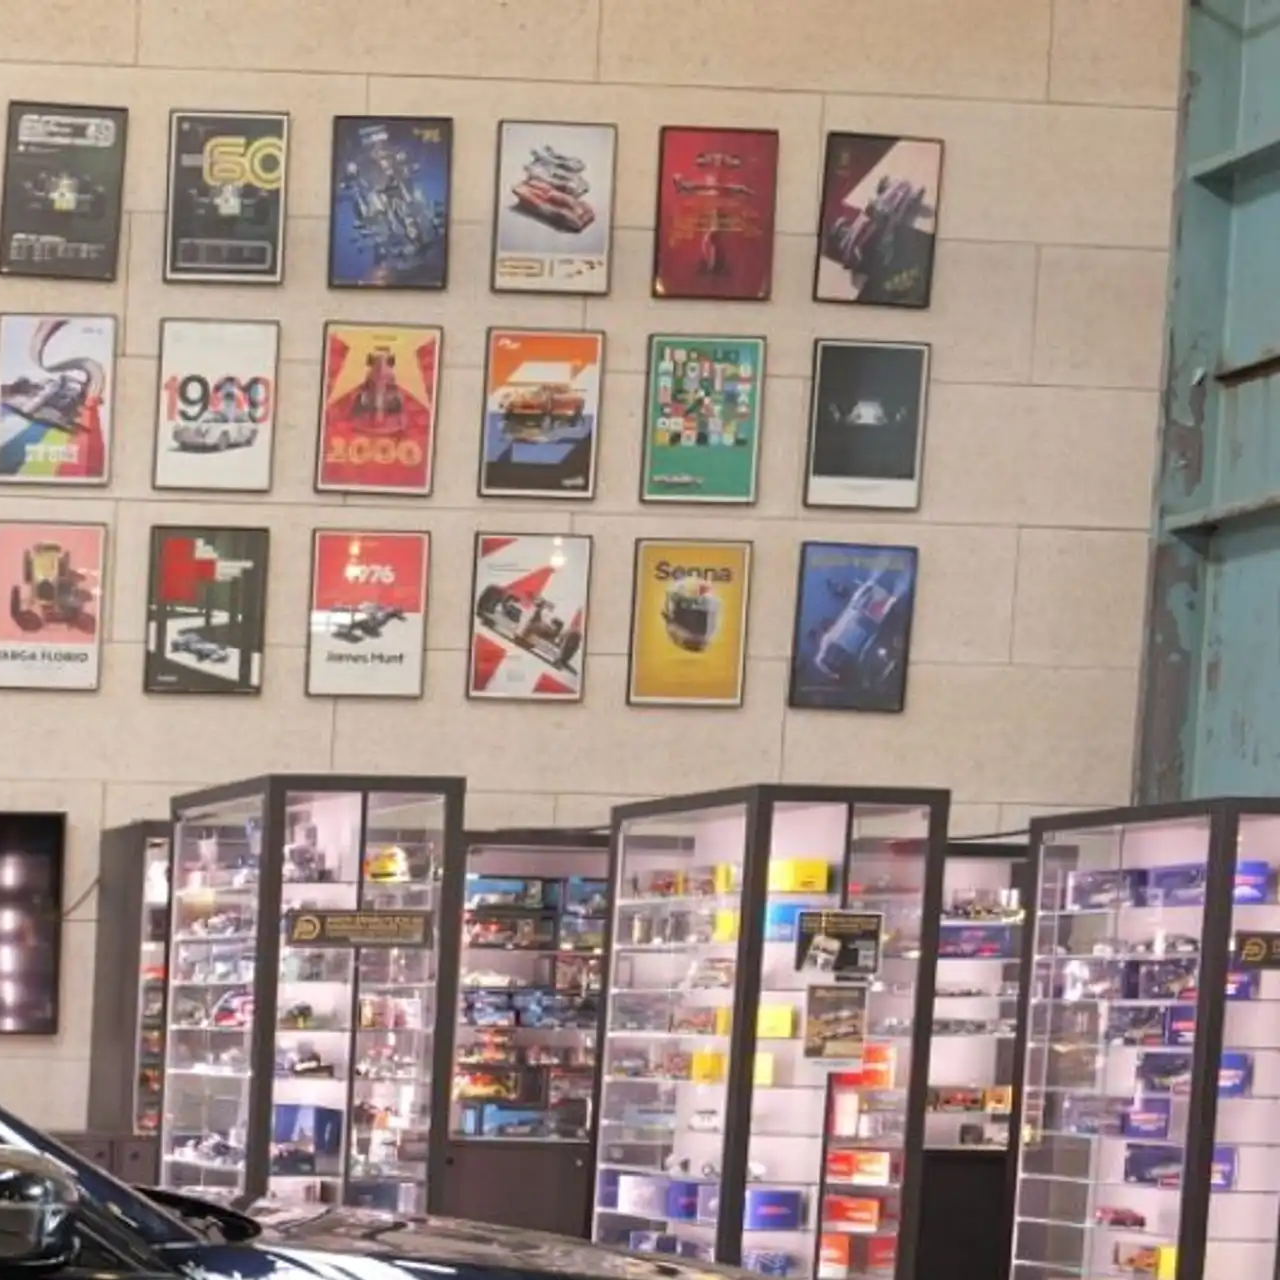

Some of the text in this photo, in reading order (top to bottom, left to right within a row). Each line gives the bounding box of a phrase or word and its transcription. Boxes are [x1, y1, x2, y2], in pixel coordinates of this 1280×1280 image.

[202, 136, 282, 190] 60
[326, 436, 422, 465] 2000
[653, 560, 733, 583] Senna
